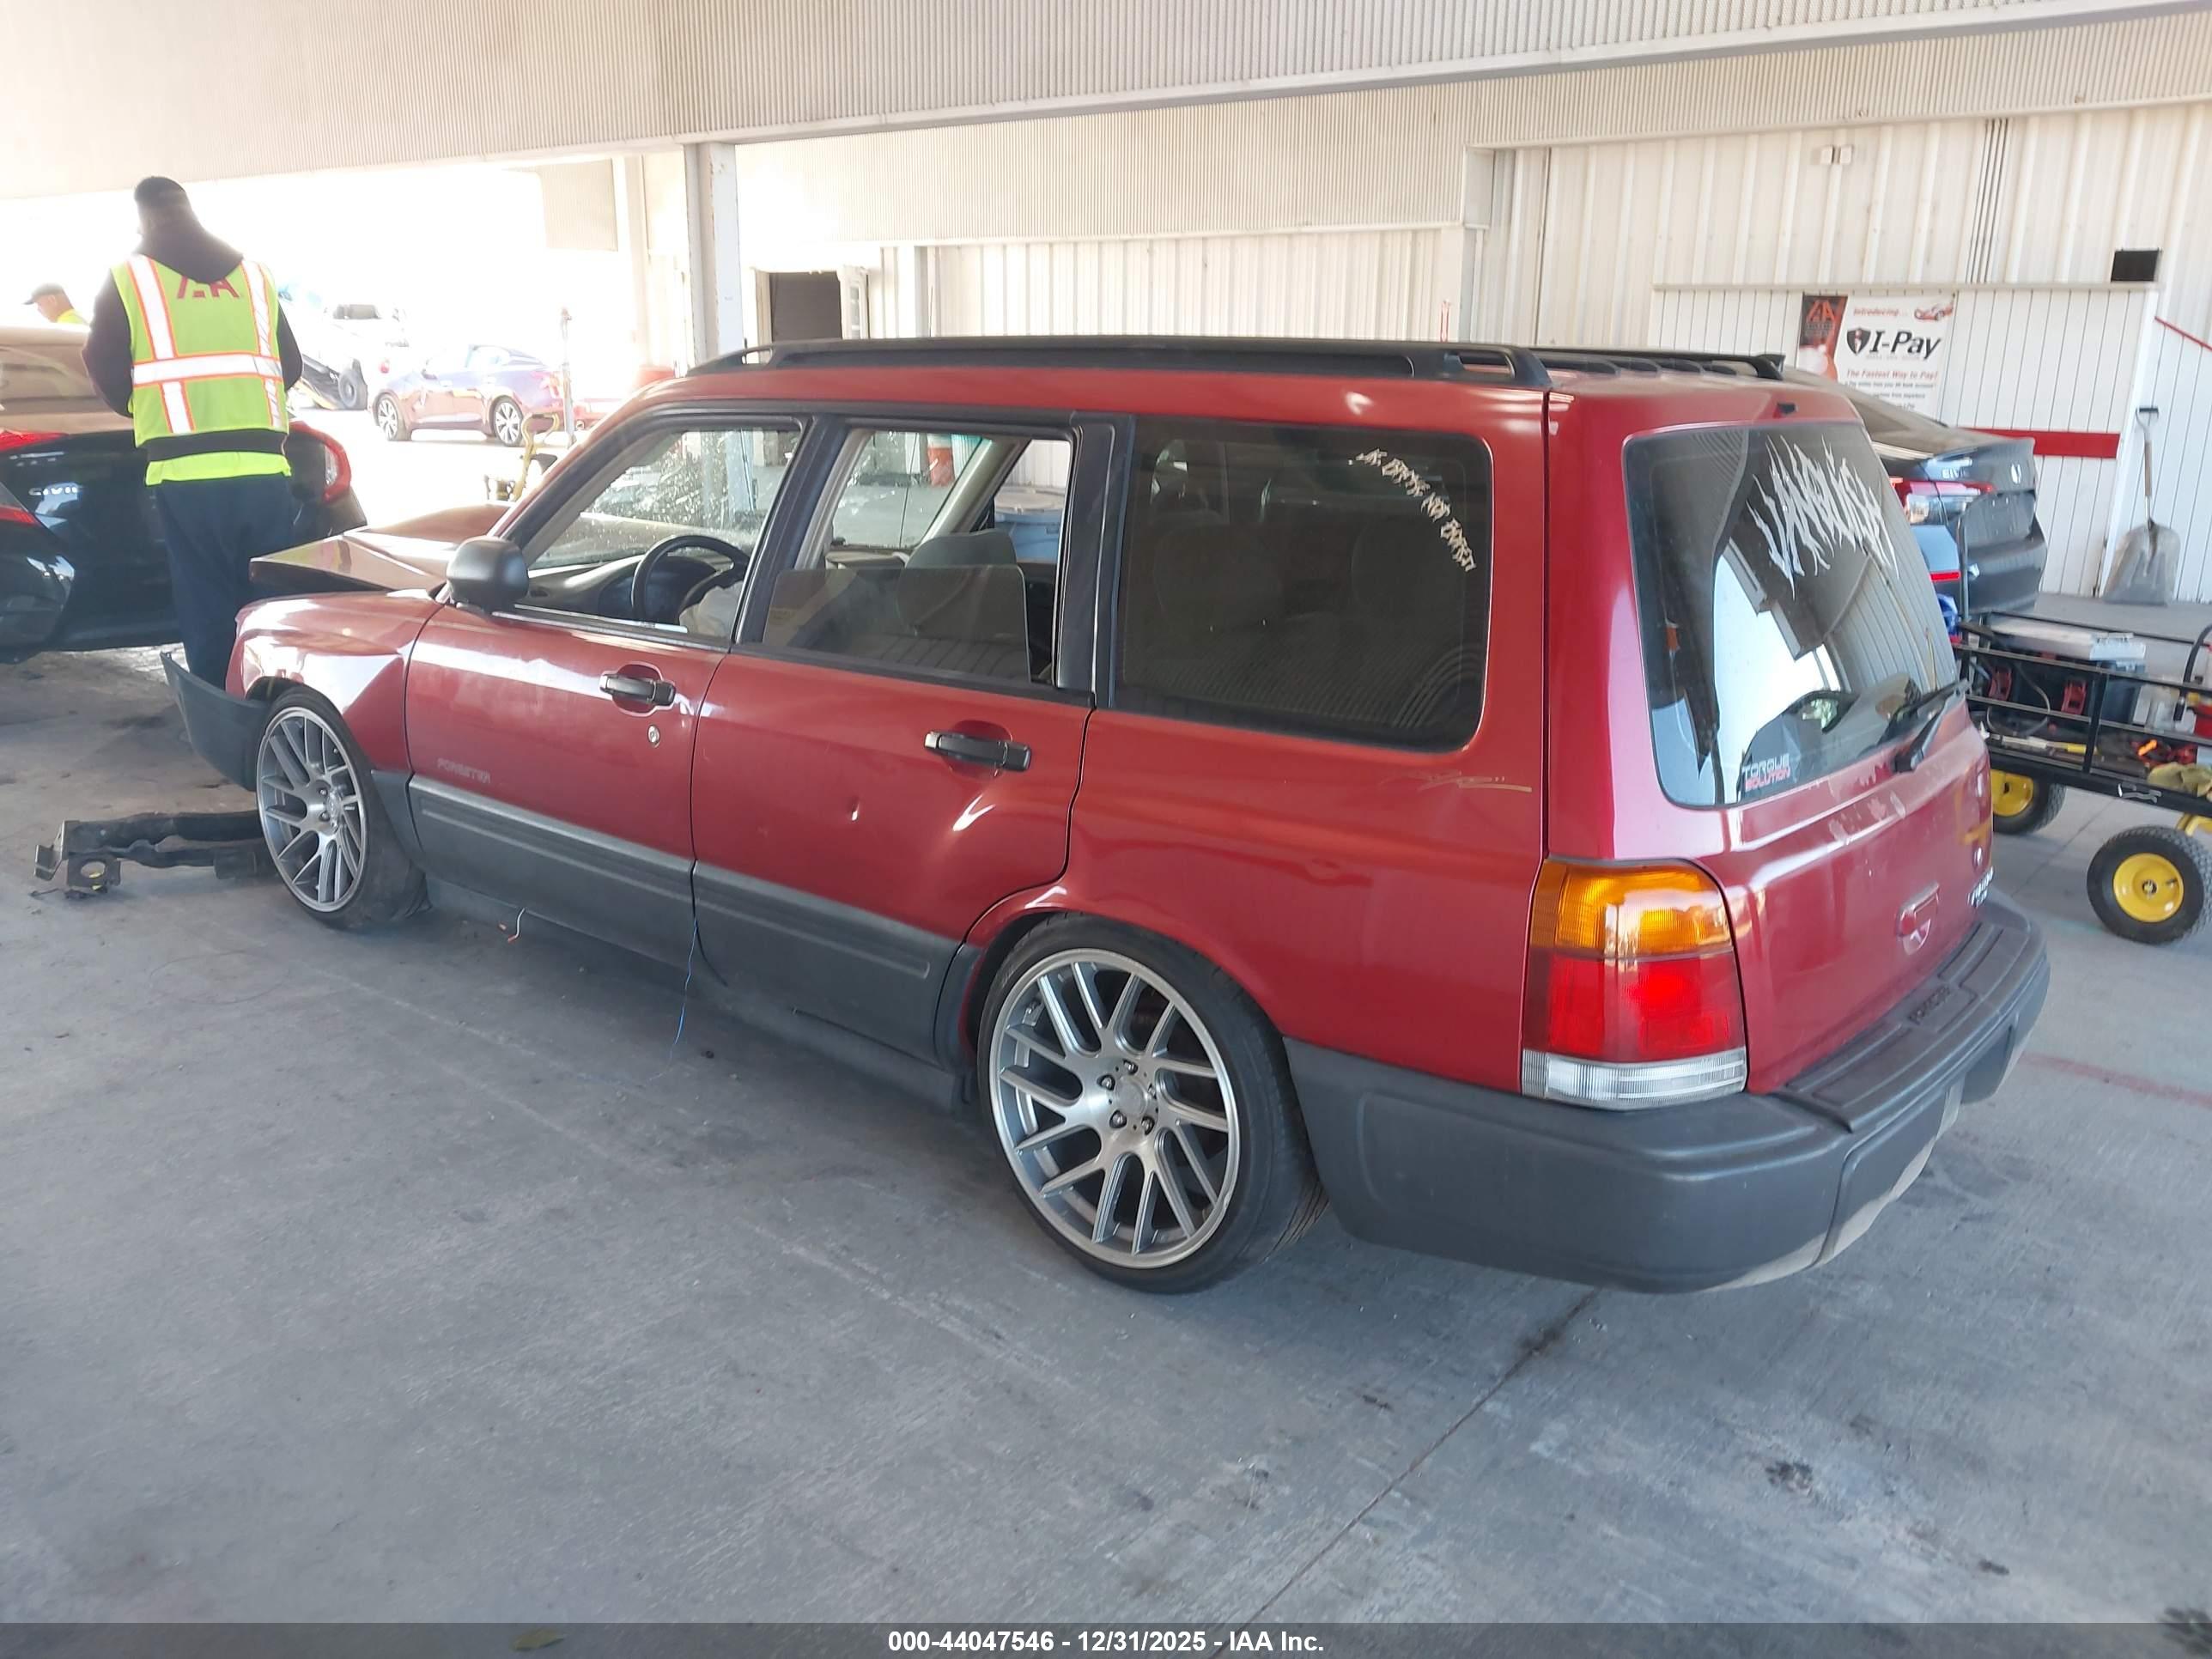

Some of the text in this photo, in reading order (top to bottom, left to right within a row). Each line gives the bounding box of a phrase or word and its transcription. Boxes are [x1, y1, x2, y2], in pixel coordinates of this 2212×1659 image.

[1869, 331, 1942, 361] I-Pay
[1847, 369, 1859, 379] The
[1861, 370, 1889, 379] Fastest
[1892, 370, 1907, 380] Way
[1741, 753, 1790, 777] TORQUE
